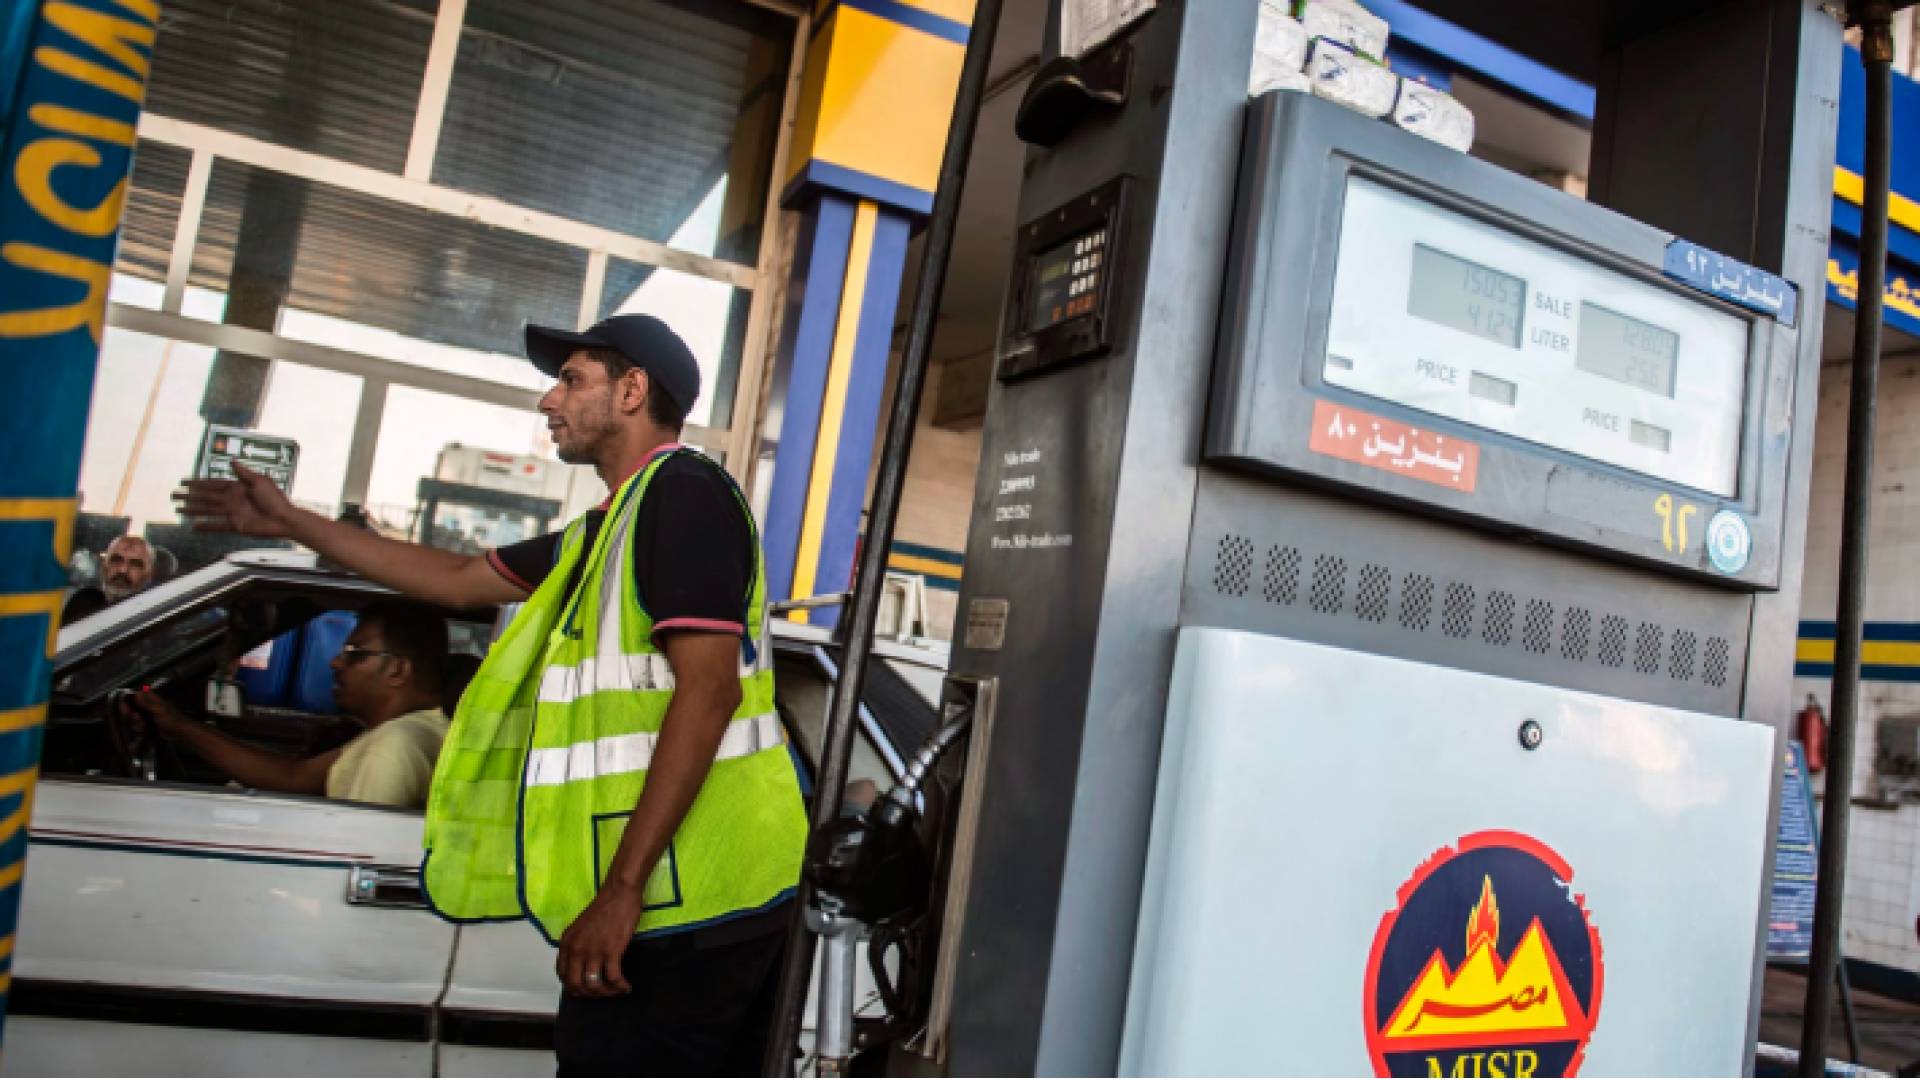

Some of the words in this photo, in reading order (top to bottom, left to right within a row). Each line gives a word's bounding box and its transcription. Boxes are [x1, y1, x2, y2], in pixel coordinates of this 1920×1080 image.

[0, 0, 161, 347] MISR
[1687, 249, 1708, 275] ٩٢
[1535, 291, 1573, 319] SALE
[1531, 326, 1570, 353] LITER
[1415, 358, 1458, 384] PRICE
[1328, 411, 1357, 441] ٨٠
[1582, 407, 1621, 432] PRICE
[1363, 421, 1464, 483] بنزين
[1654, 493, 1697, 555] ٩٢
[1403, 984, 1549, 1033] مصر
